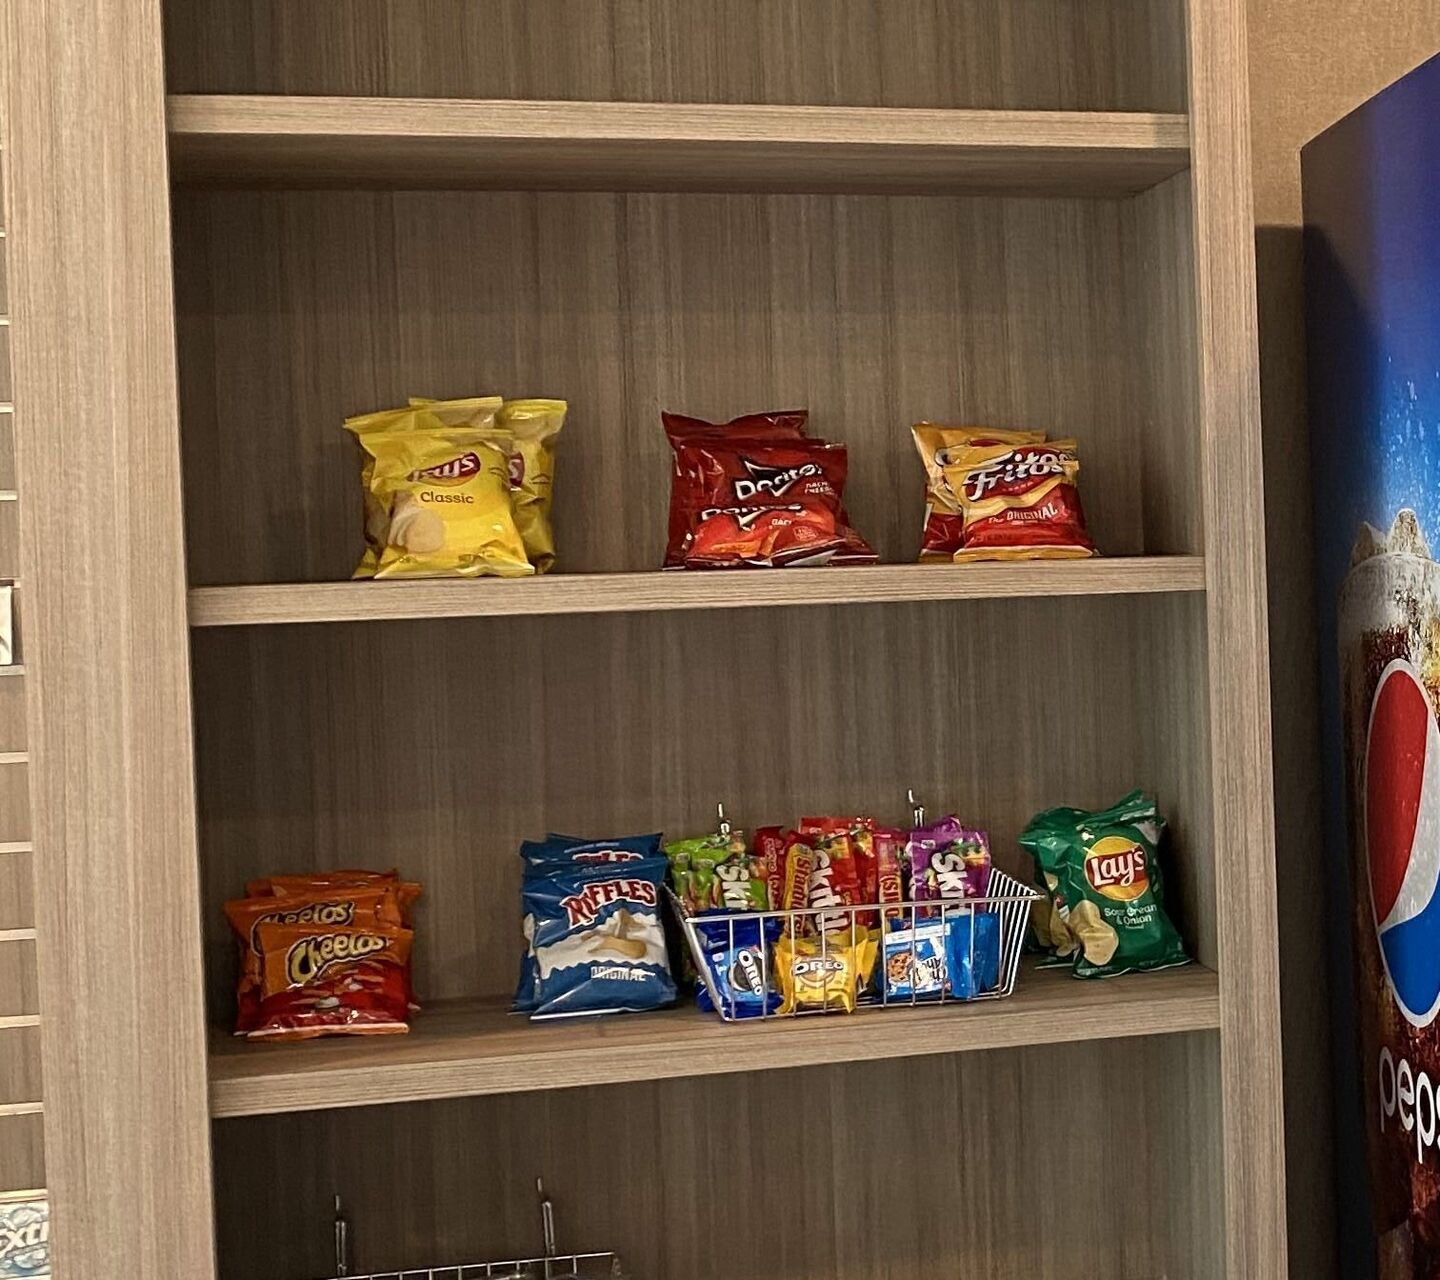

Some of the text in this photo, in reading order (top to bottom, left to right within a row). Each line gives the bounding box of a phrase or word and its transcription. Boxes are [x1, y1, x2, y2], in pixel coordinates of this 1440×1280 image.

[420, 491, 475, 505] Classic
[1007, 502, 1058, 521] ORIGINAL
[1091, 846, 1144, 887] Lay's
[561, 880, 656, 929] RUFFLES
[1123, 914, 1152, 926] Onion
[287, 933, 388, 985] Cheetos
[738, 949, 763, 997] OREO
[794, 960, 845, 977] OREO
